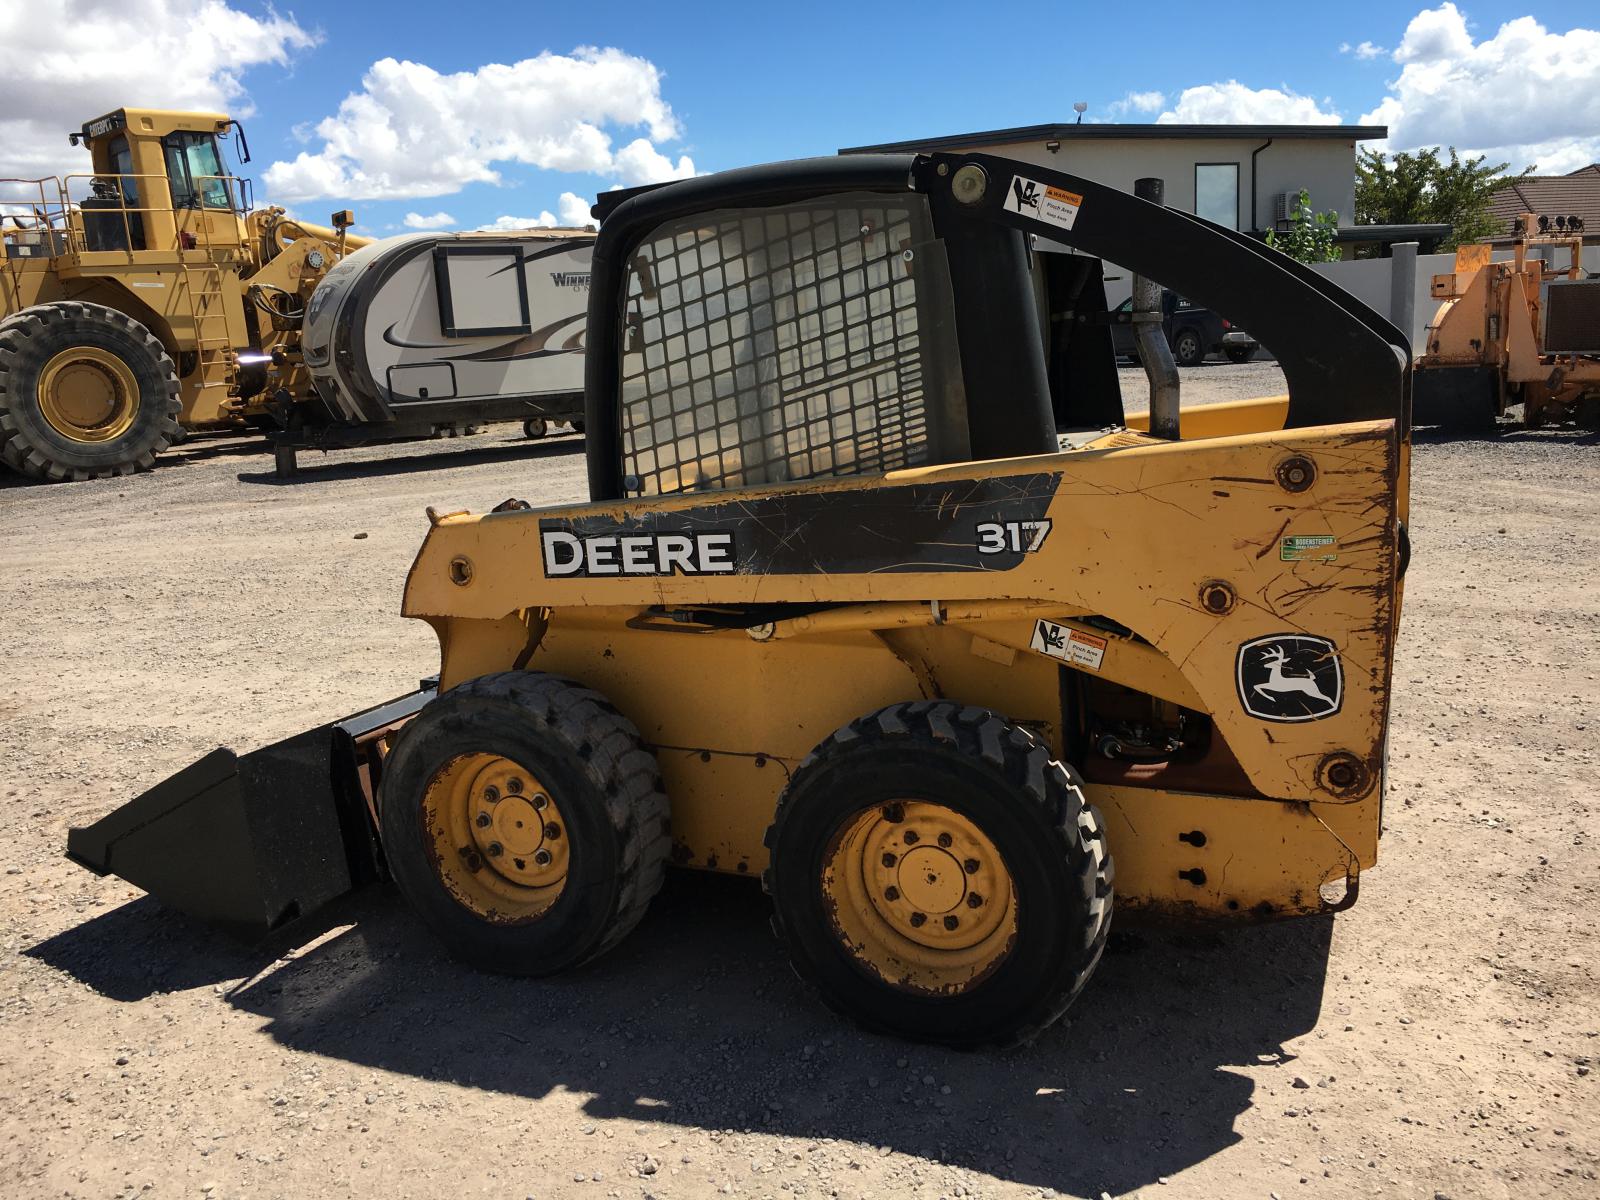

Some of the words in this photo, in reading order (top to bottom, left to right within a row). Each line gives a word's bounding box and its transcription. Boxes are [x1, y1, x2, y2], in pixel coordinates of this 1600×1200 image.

[1053, 191, 1079, 203] WARNING
[1047, 202, 1061, 210] Pinch
[1061, 207, 1073, 215] Area
[977, 521, 1050, 553] 317
[543, 531, 734, 575] DEERE
[1072, 644, 1086, 653] Pinch
[1086, 649, 1098, 657] Area
